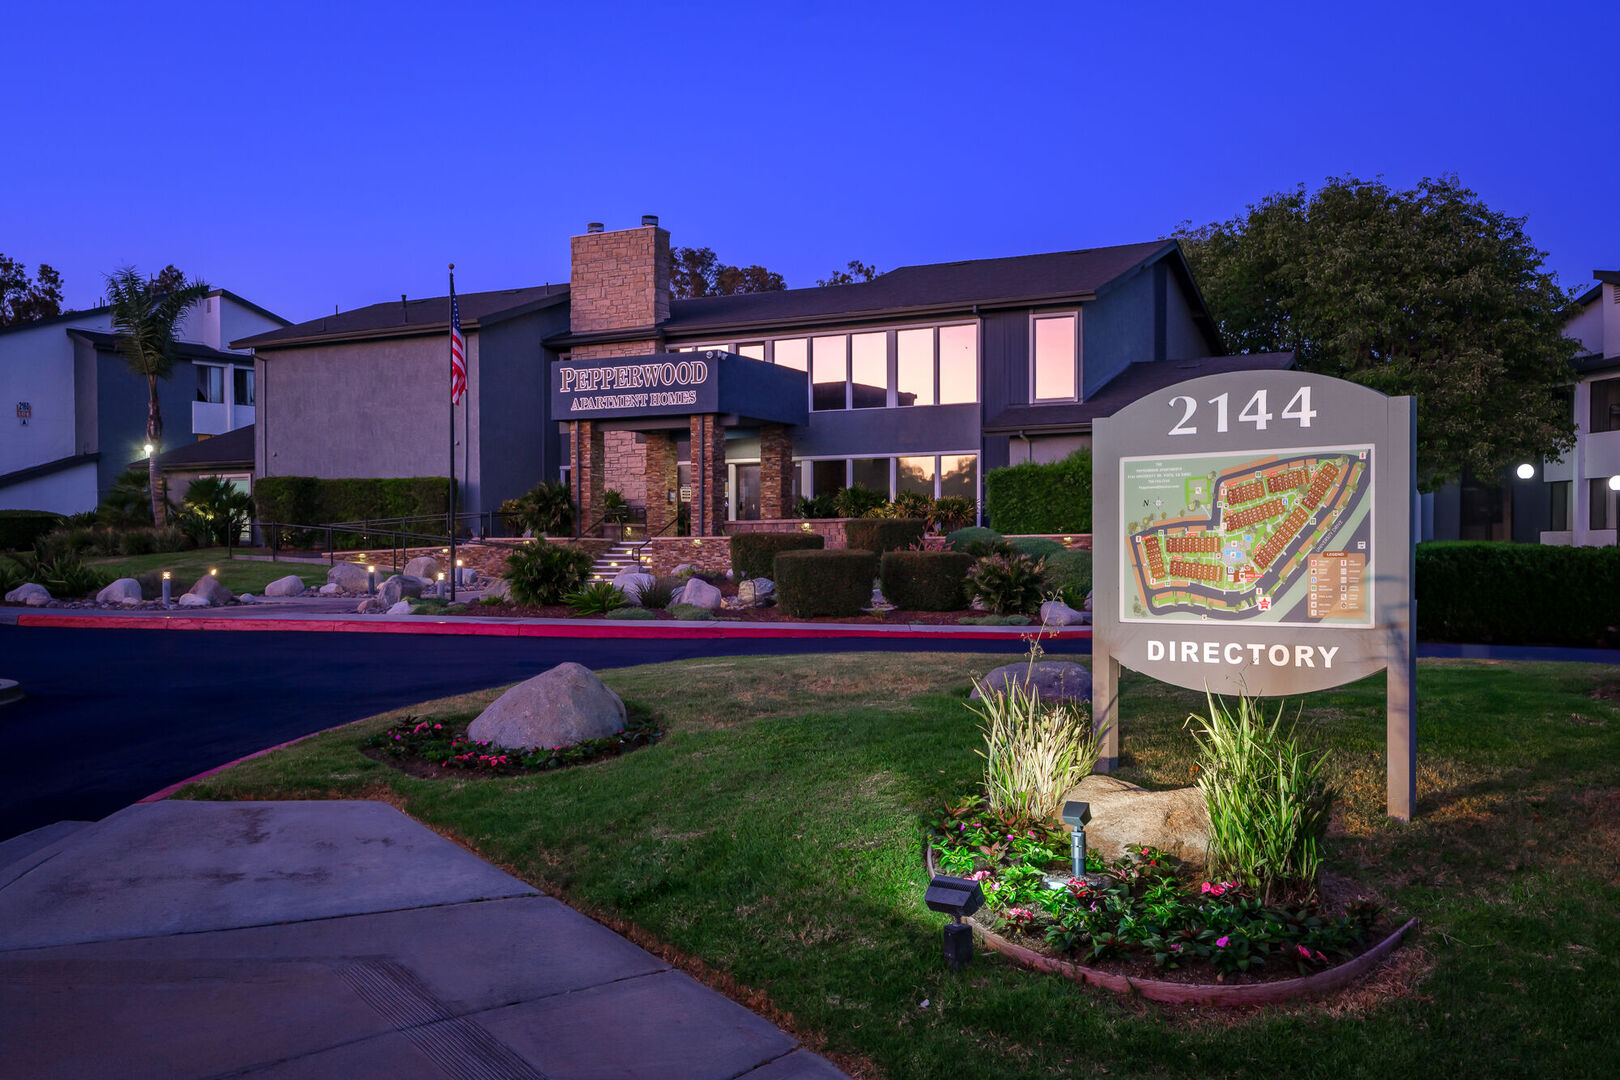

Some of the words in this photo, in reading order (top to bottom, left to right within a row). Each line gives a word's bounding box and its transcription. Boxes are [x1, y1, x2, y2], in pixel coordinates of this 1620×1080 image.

[560, 361, 708, 393] PEPPERWOOD
[571, 393, 648, 411] APARTMENT
[650, 390, 697, 407] HOMES
[1168, 386, 1317, 436] 2144
[1143, 499, 1150, 507] N
[1147, 640, 1340, 668] DIRECTORY
